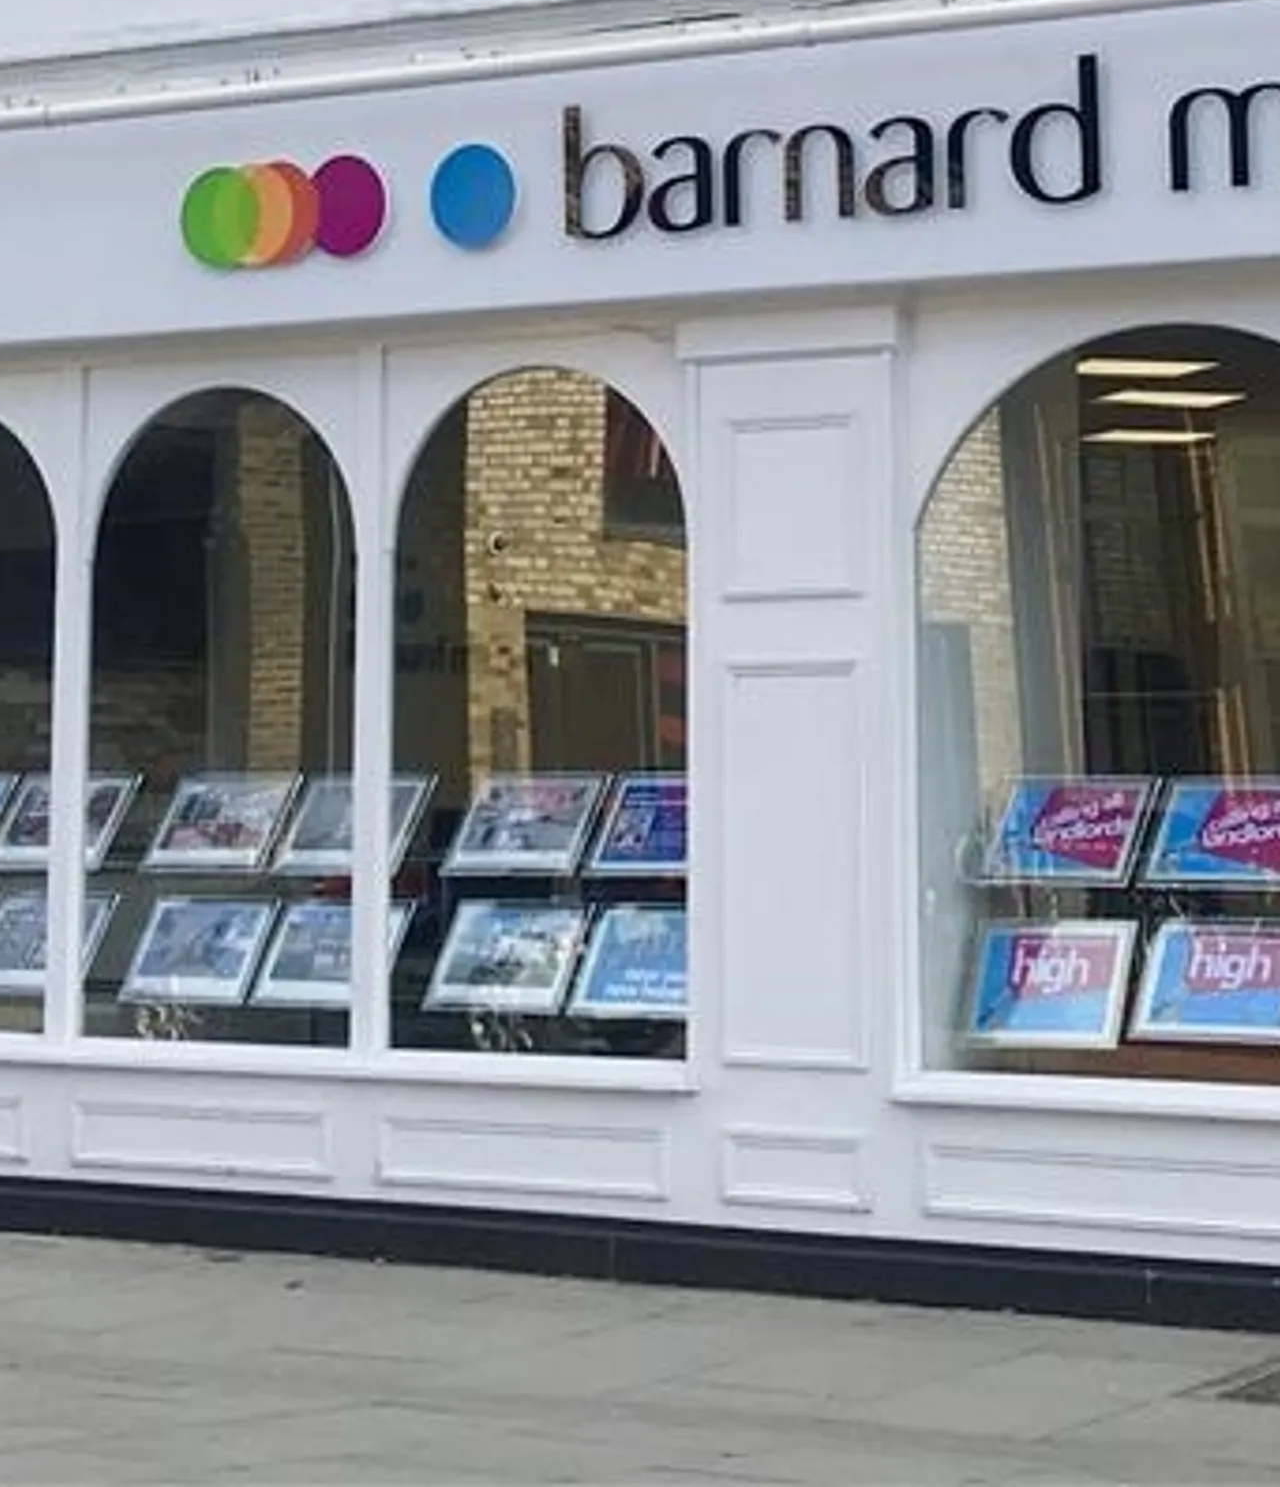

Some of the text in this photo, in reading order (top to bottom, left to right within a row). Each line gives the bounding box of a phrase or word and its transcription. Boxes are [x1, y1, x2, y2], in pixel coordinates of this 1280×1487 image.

[562, 53, 1104, 241] barnard
[1011, 943, 1089, 995] high
[1189, 939, 1271, 991] high
